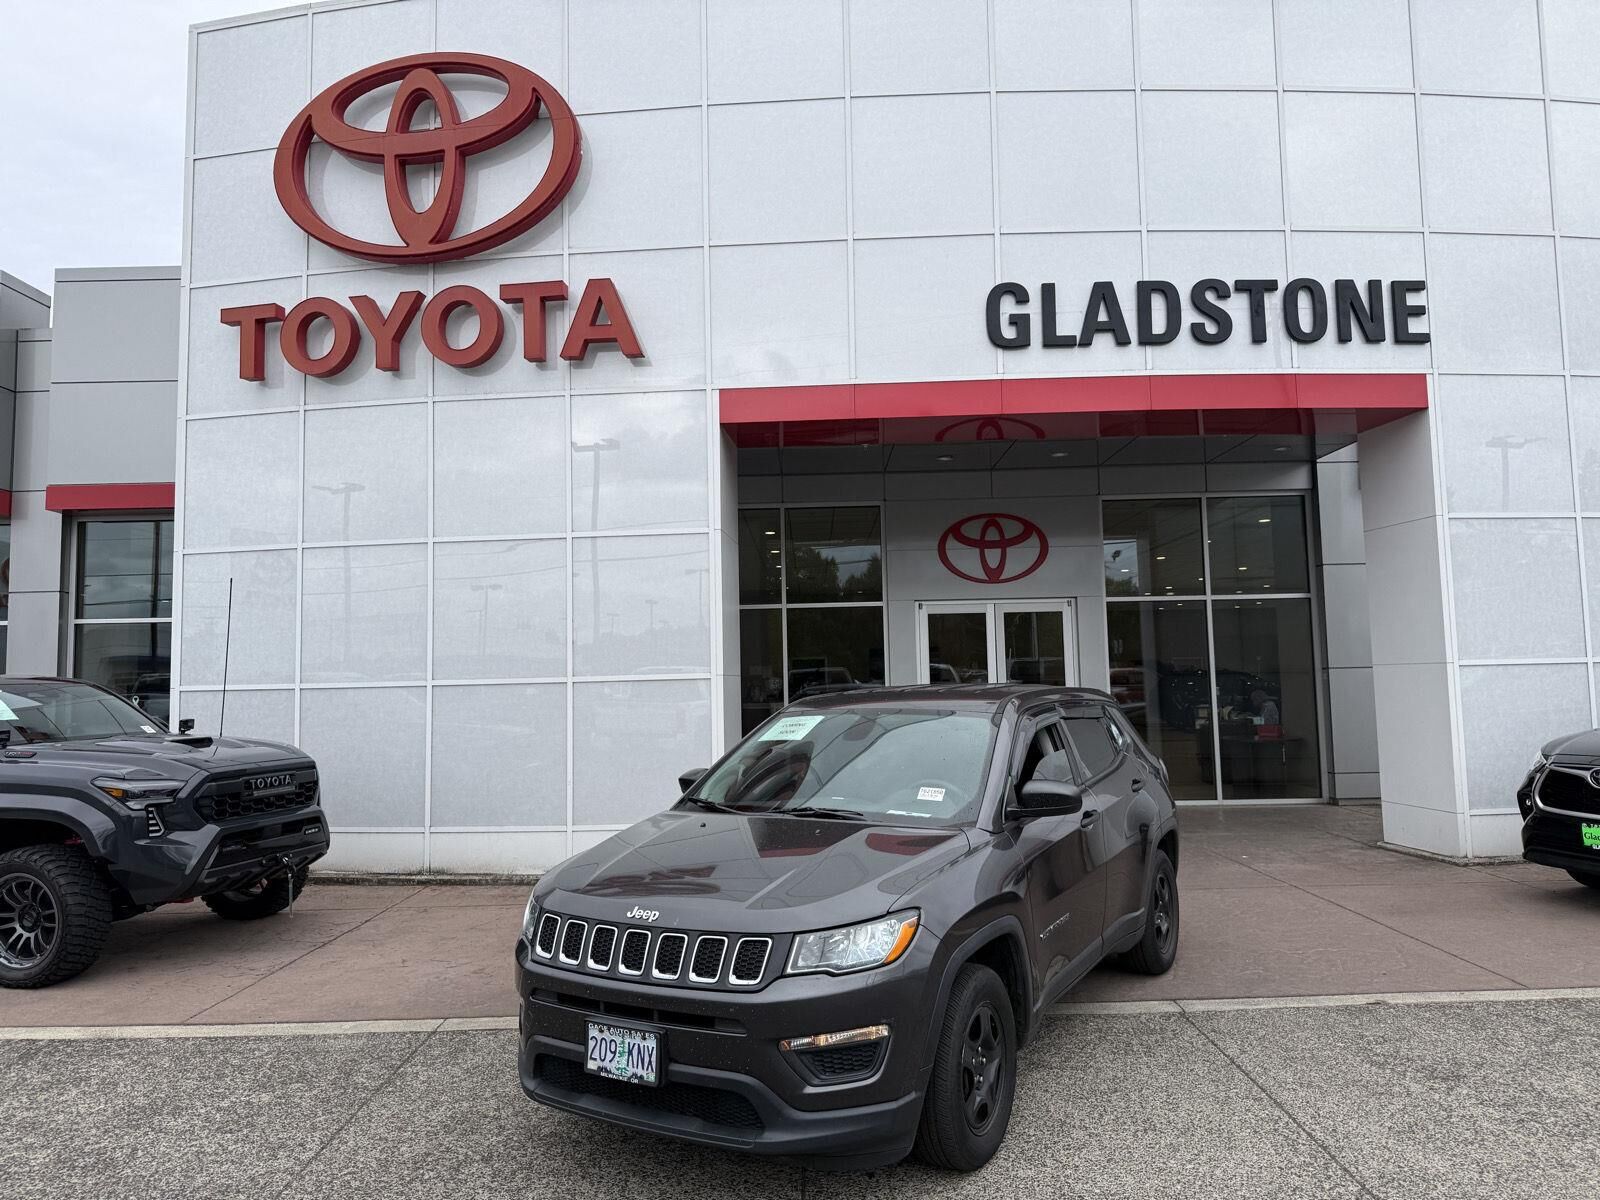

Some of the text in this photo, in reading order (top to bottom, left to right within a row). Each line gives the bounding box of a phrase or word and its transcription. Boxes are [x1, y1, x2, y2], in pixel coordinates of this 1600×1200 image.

[985, 277, 1431, 348] GLADSTONE
[220, 277, 646, 382] TOYOTA
[250, 774, 292, 790] TOYOTA
[626, 905, 660, 923] Jeep
[610, 1027, 630, 1036] AUTO
[589, 1035, 655, 1072] 209 KNX
